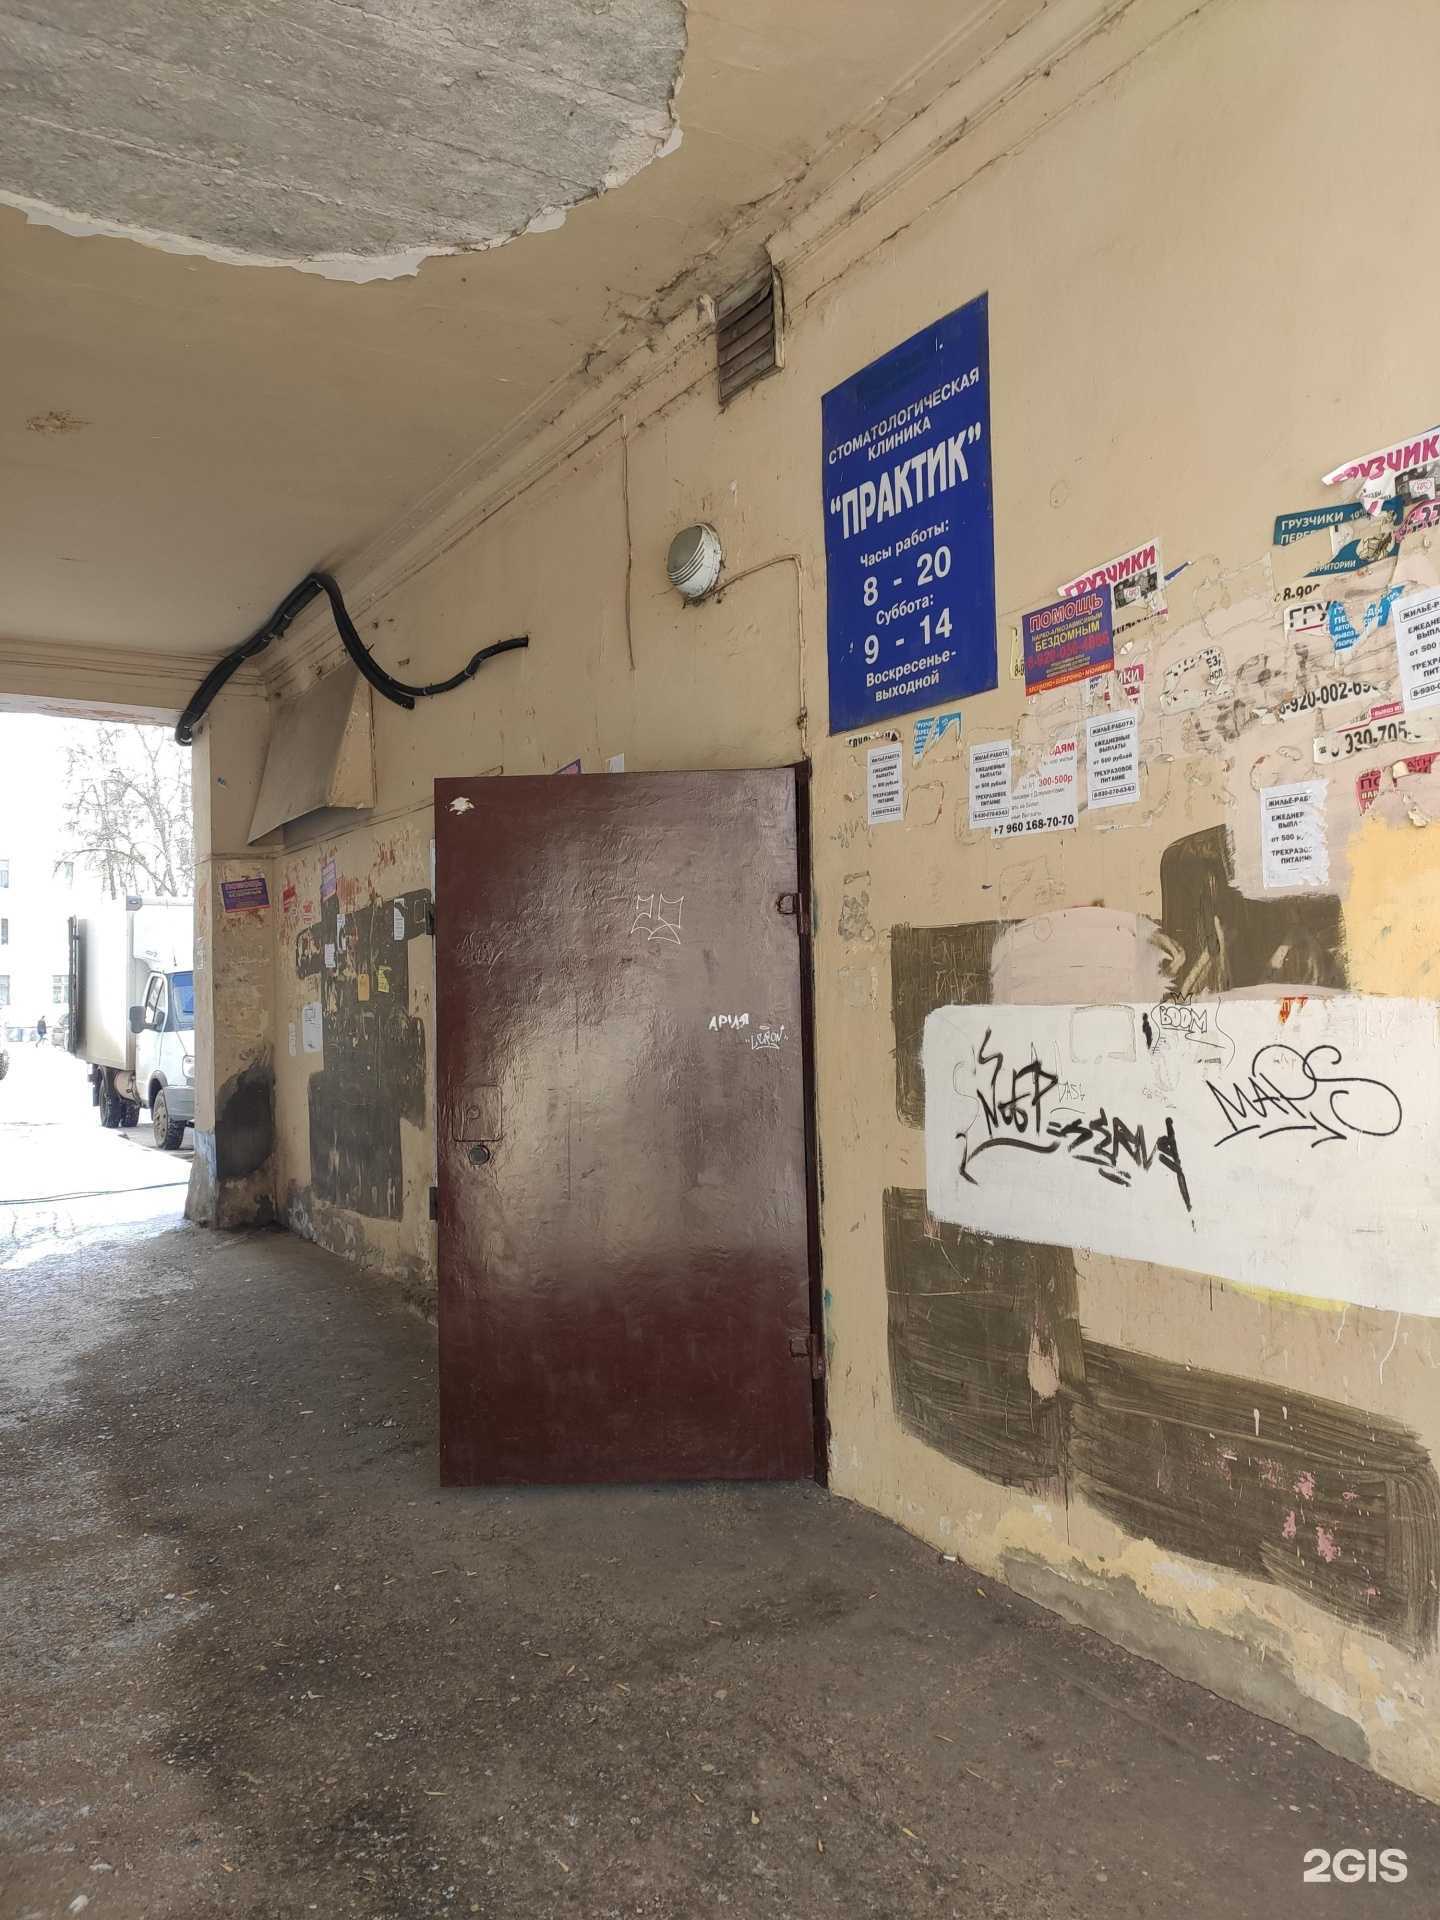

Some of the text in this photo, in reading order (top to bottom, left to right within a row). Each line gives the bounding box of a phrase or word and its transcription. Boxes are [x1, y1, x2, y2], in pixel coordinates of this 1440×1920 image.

[828, 367, 980, 464] СТОМАТОЛОГИЧЕСКАЯ
[868, 416, 932, 461] КЛИНИКА
[1281, 511, 1344, 531] ГРУЗЧИКИ
[860, 519, 950, 568] Часы работы:
[863, 576, 879, 607] 8
[917, 546, 951, 586] 20
[876, 594, 934, 626] Суббота:
[1030, 593, 1104, 632] ПОМОЩЬ
[864, 635, 880, 664] 9
[919, 607, 953, 645] 14
[1035, 621, 1100, 652] БЕЗДОМНЫМ
[1409, 642, 1437, 657] от 500
[875, 669, 940, 702] выходной
[1268, 795, 1311, 807] ЖИЛЬЁ-РАБ
[994, 825, 1005, 836] +7
[1006, 822, 1024, 834] 960
[1025, 815, 1074, 831] 168-70-70
[1278, 821, 1301, 829] ВЫПЛ
